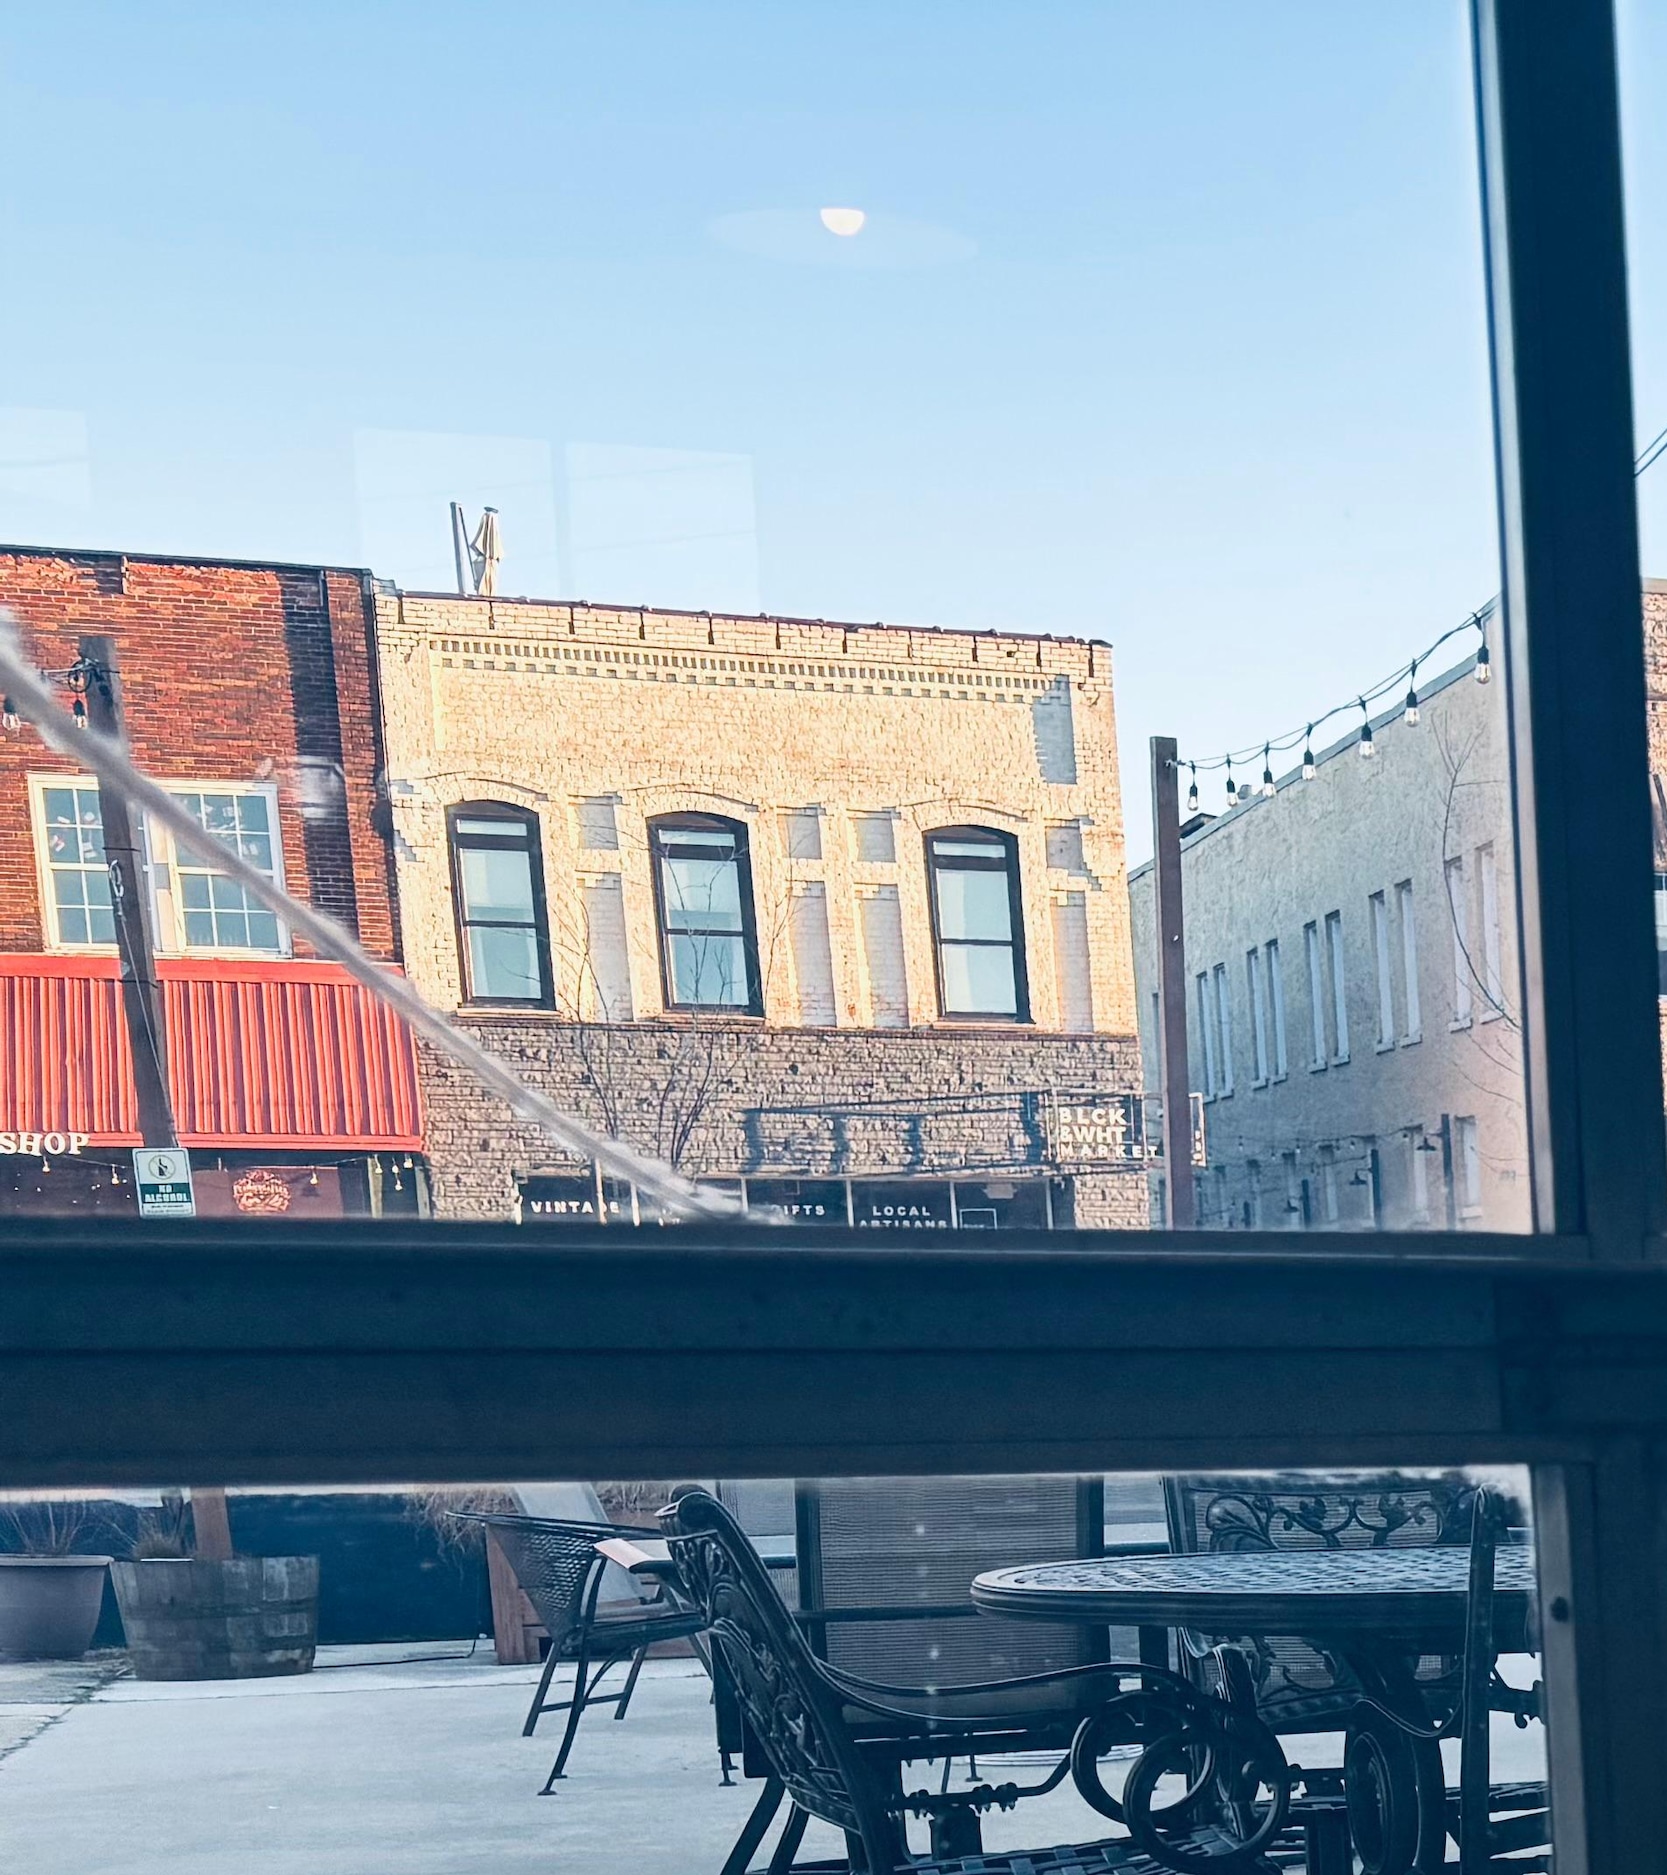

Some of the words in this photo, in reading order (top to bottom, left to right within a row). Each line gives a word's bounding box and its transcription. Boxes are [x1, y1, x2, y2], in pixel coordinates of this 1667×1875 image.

[1059, 1107, 1127, 1125] BLCK
[0, 1132, 90, 1155] SHOP
[1059, 1145, 1158, 1159] MARKET
[530, 1201, 620, 1213] VINTAE
[872, 1205, 931, 1216] LOCAL
